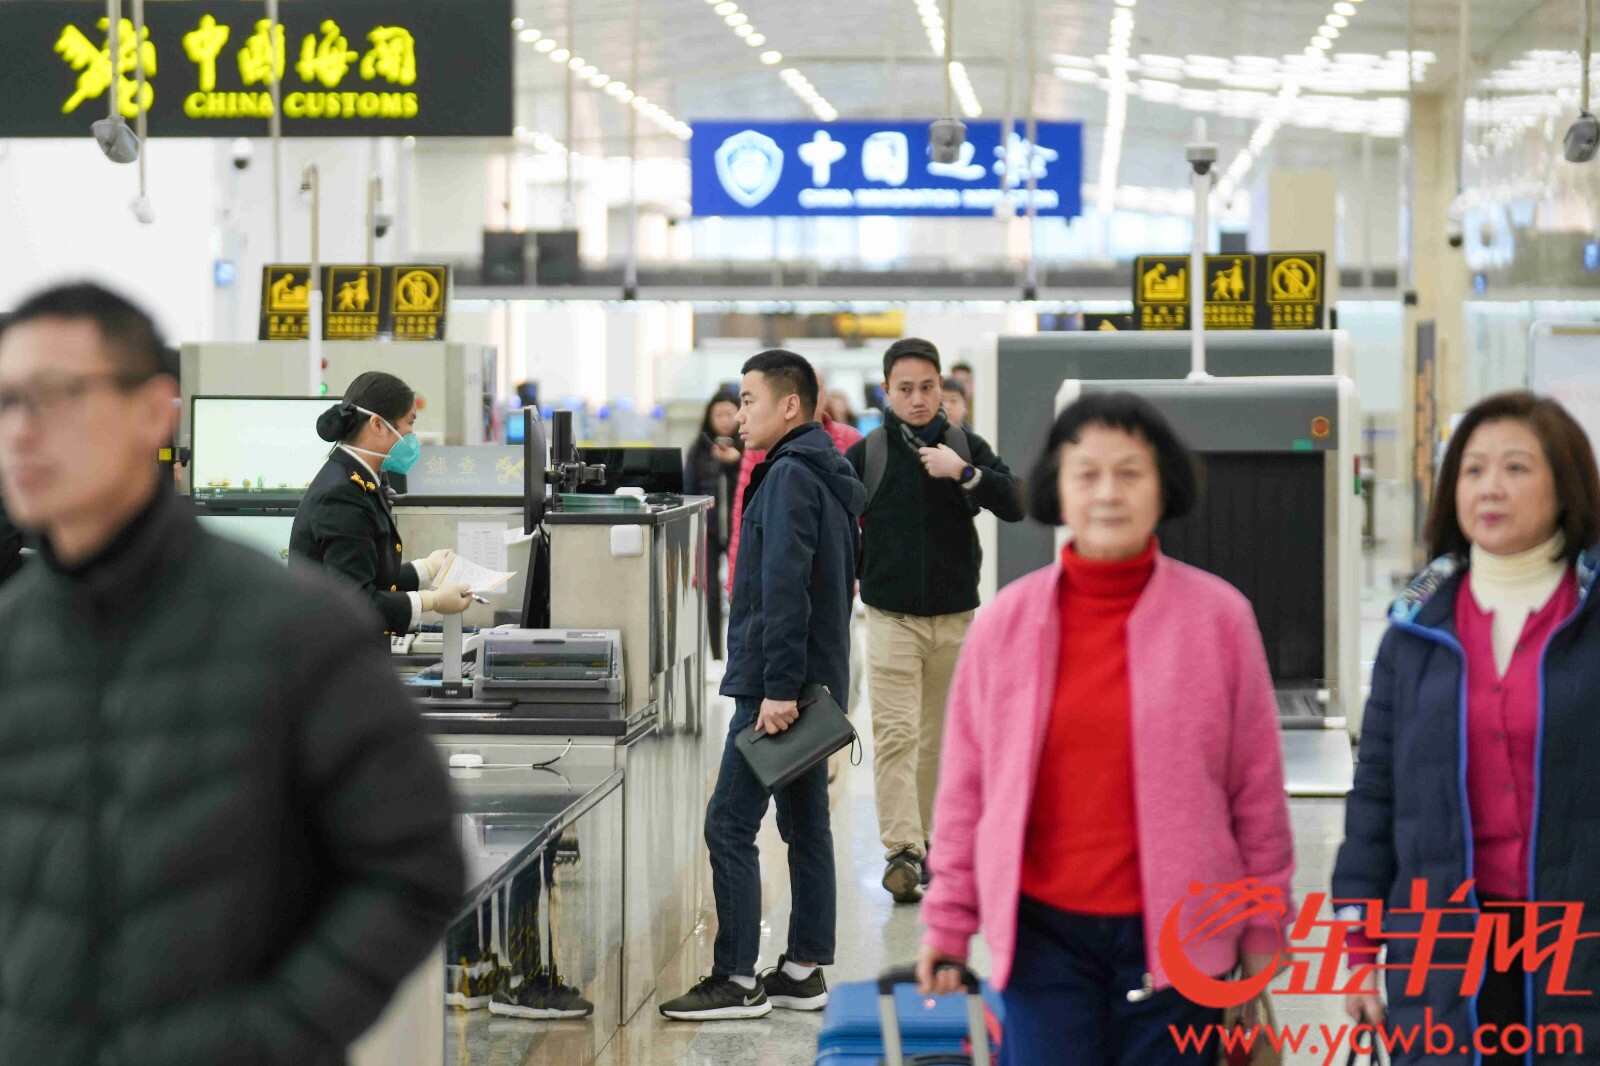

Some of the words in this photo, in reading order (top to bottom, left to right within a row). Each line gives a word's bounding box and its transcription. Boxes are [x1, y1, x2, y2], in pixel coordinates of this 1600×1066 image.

[182, 14, 417, 92] 中国海关
[184, 92, 275, 119] CHINA
[283, 92, 418, 119] CUSTOMS
